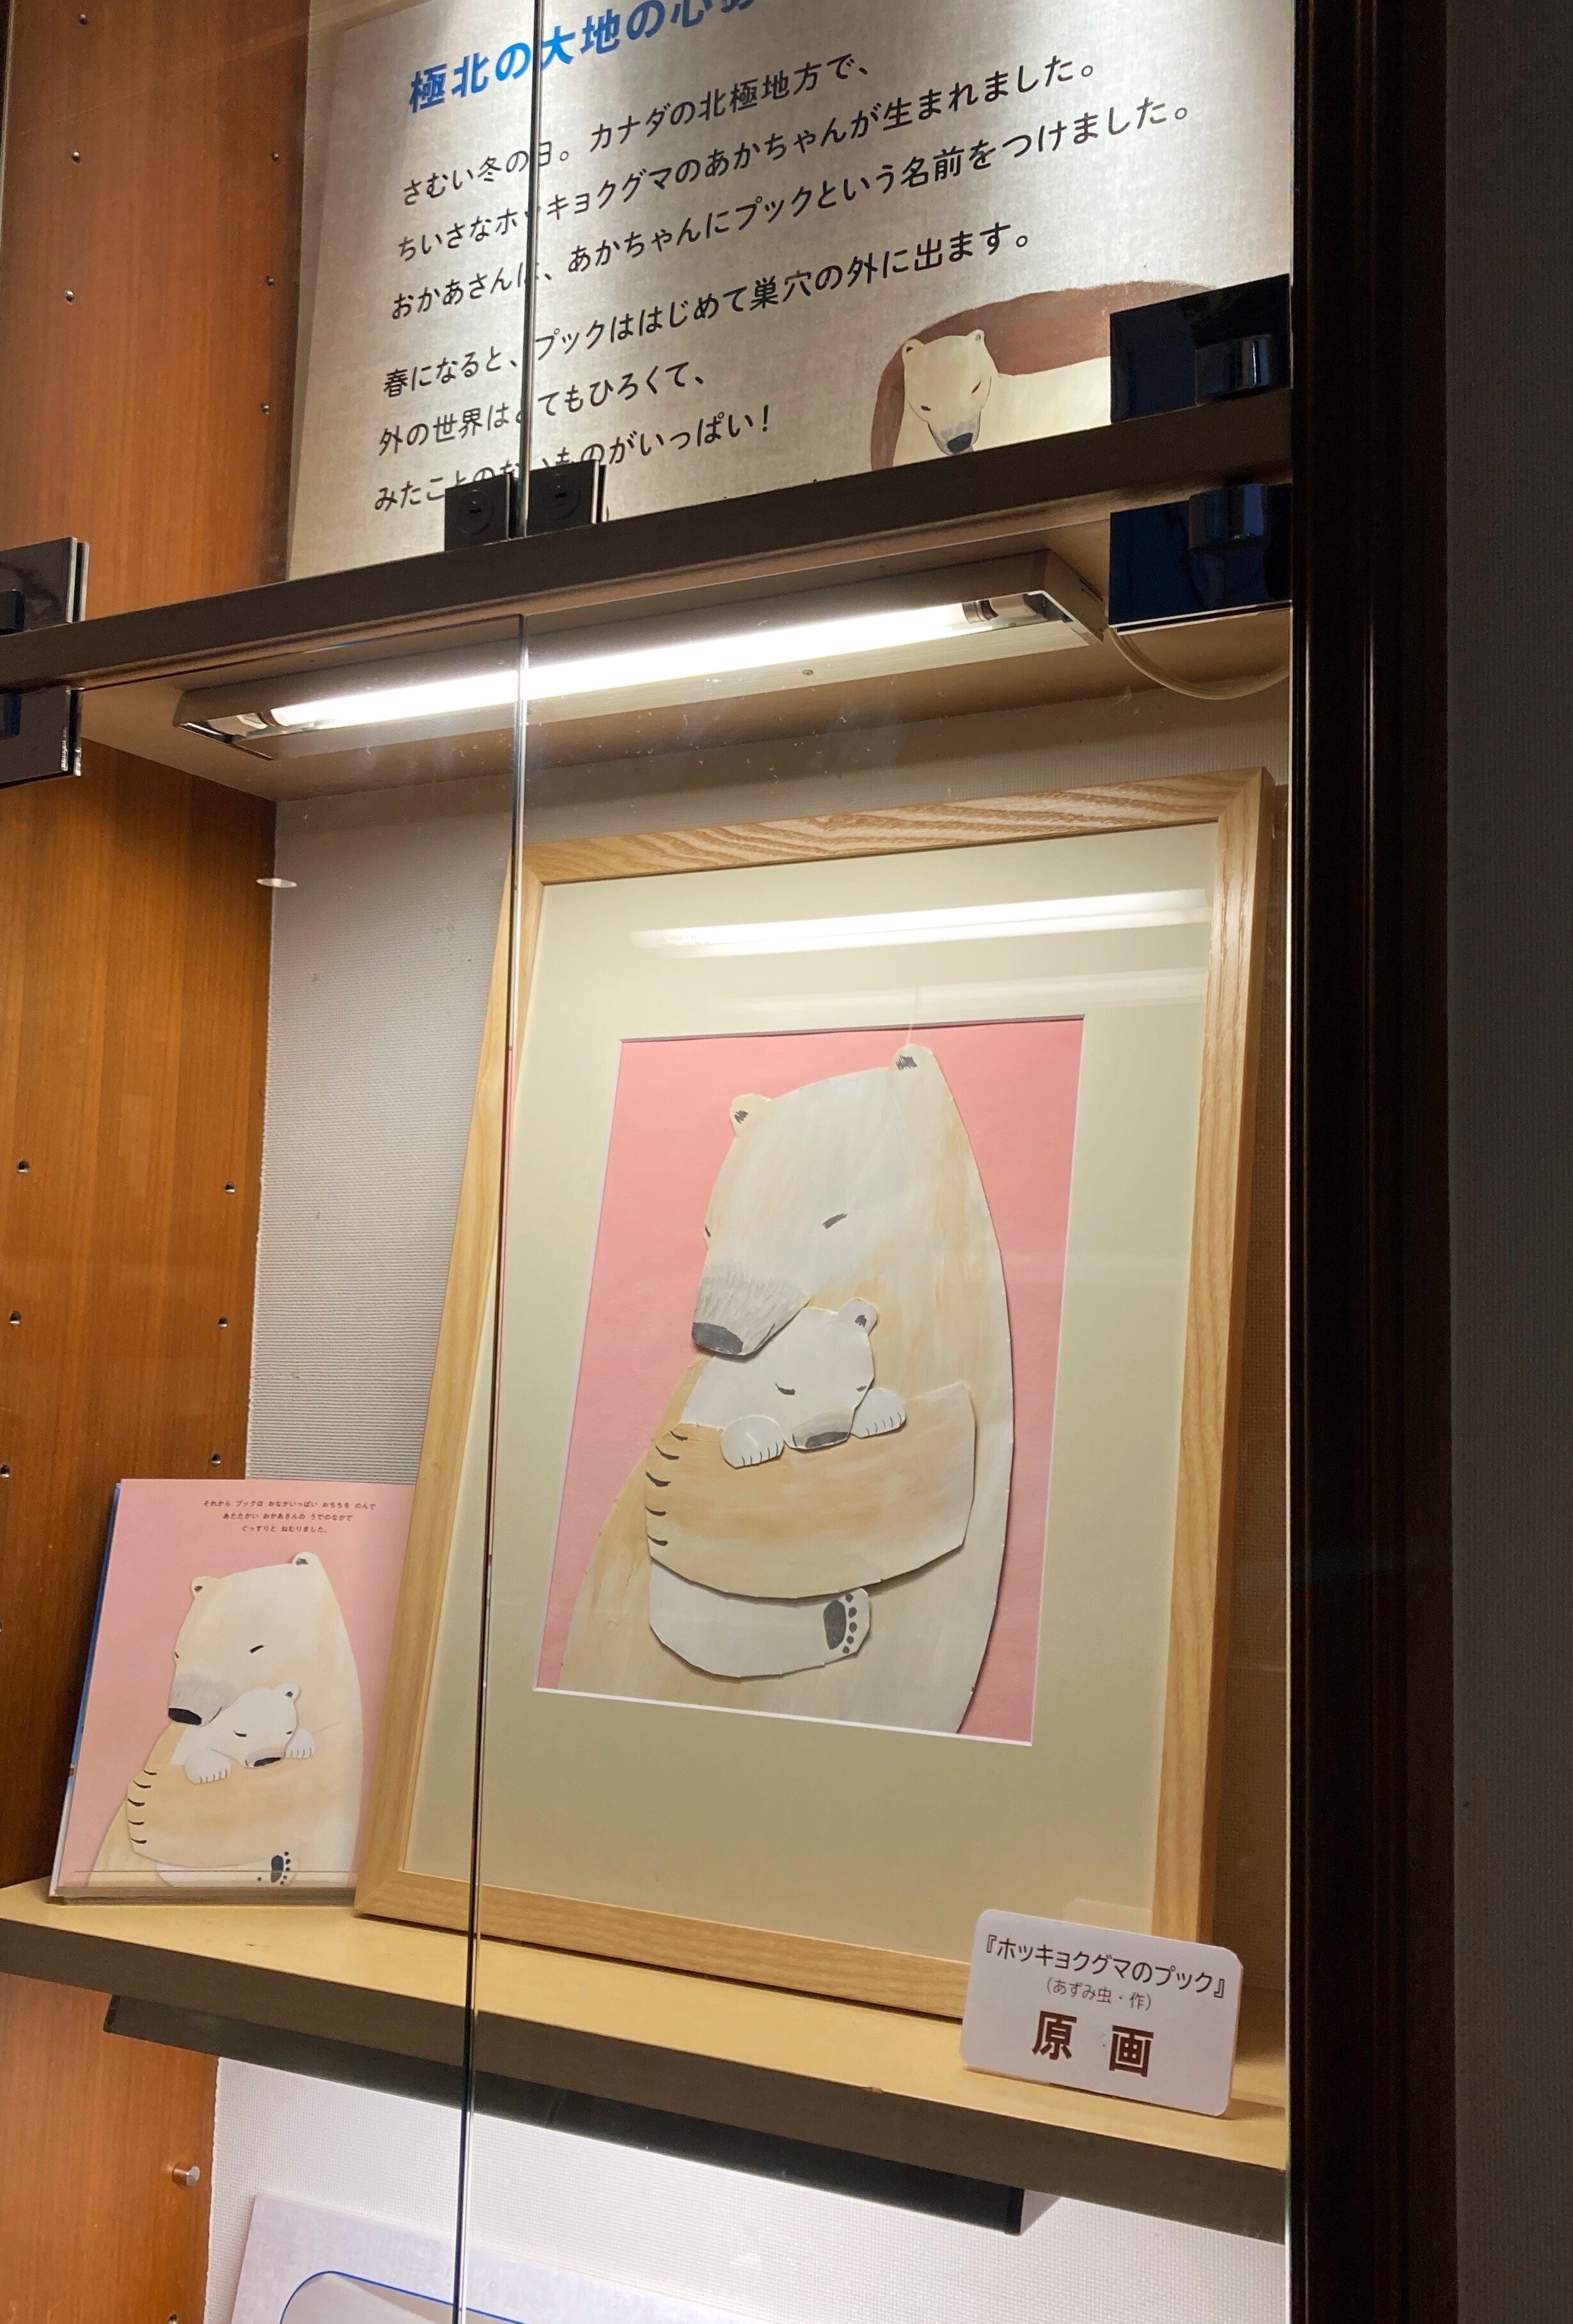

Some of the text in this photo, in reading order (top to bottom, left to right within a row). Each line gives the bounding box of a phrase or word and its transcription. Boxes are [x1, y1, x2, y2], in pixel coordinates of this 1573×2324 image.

[409, 0, 755, 113] 極北の大地の心
[398, 55, 1094, 262] ちいさなホキョクグマのあかちゃんが生まれました。
[403, 53, 868, 205] さむい冬の日。カナダの北極地方で、
[384, 222, 1028, 398] 春になると、プックははじめて巣穴の外に出ます。
[379, 361, 704, 457] 外の世界はてもひろくて、
[986, 1935, 1226, 1998] 『ホッキョクグマのプック』
